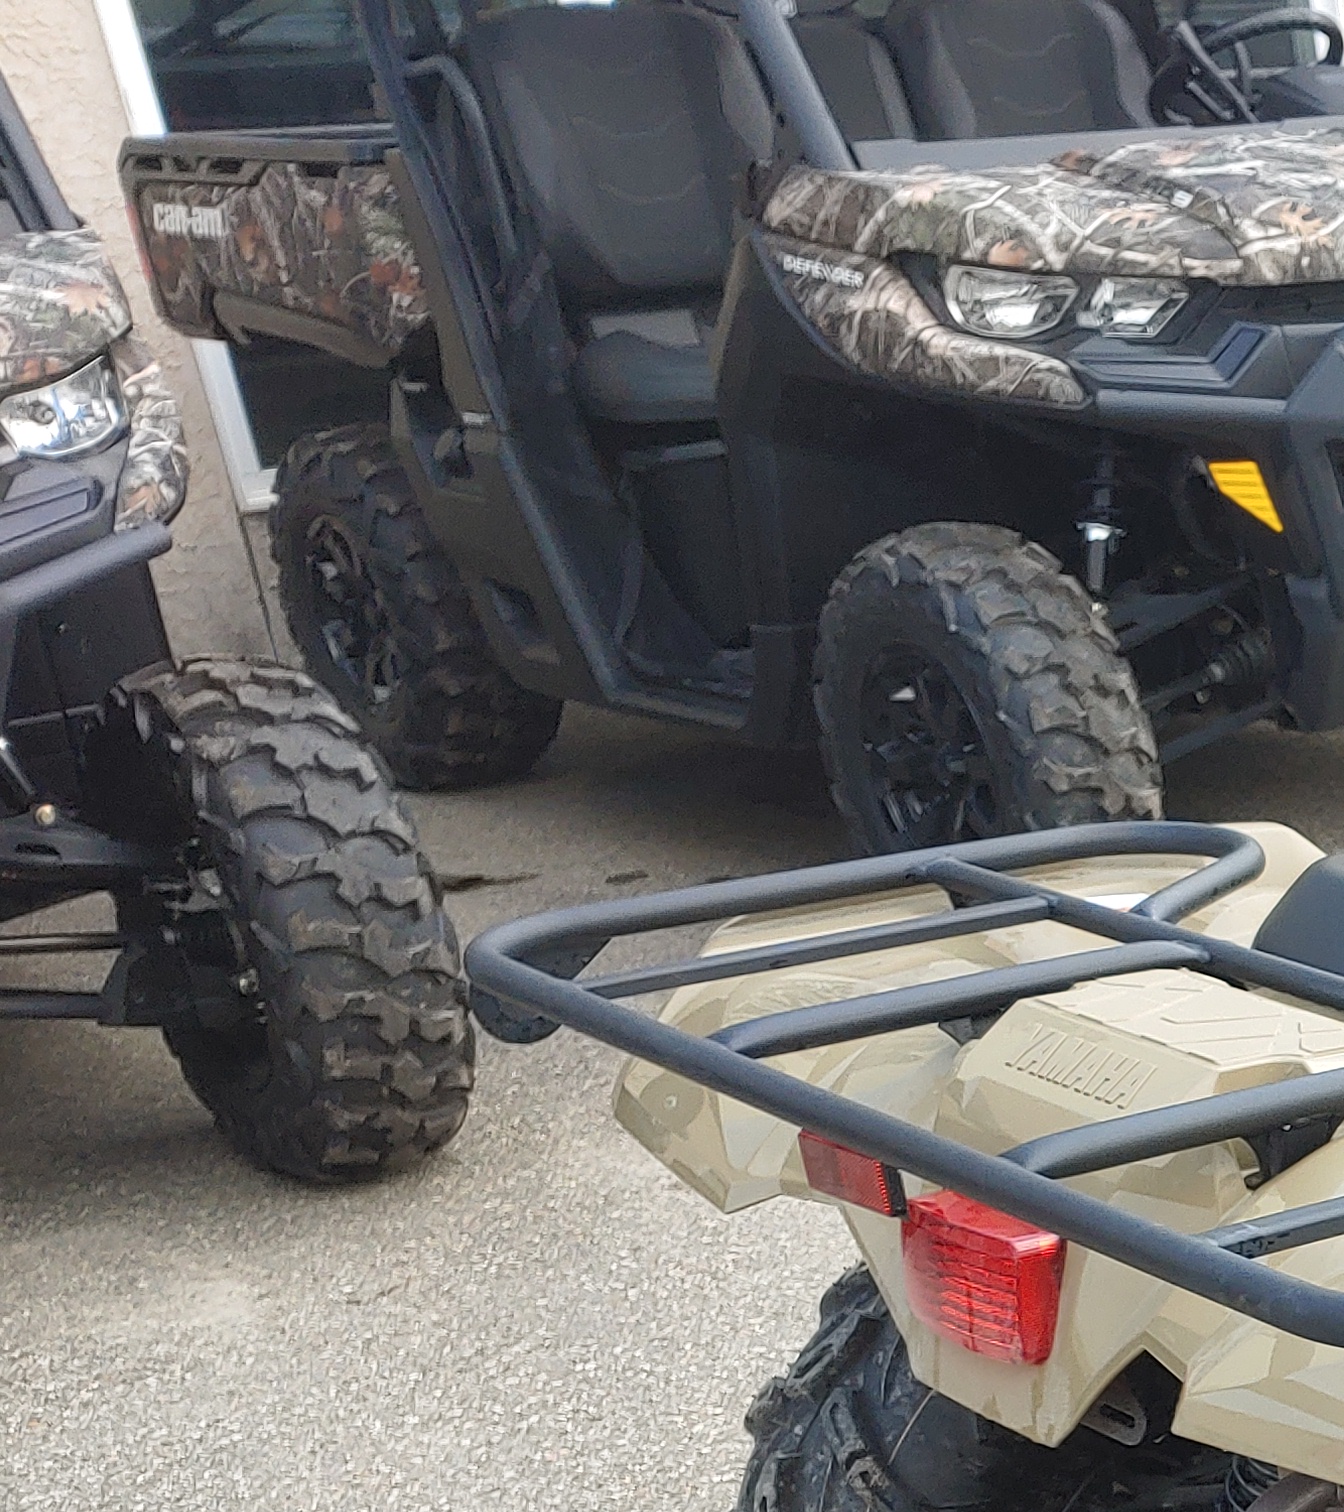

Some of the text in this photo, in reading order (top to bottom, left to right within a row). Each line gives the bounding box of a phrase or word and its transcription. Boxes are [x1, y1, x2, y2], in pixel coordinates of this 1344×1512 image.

[153, 202, 223, 239] can-am
[783, 254, 865, 290] DEFENDER
[1004, 1022, 1158, 1110] YAMAHA
